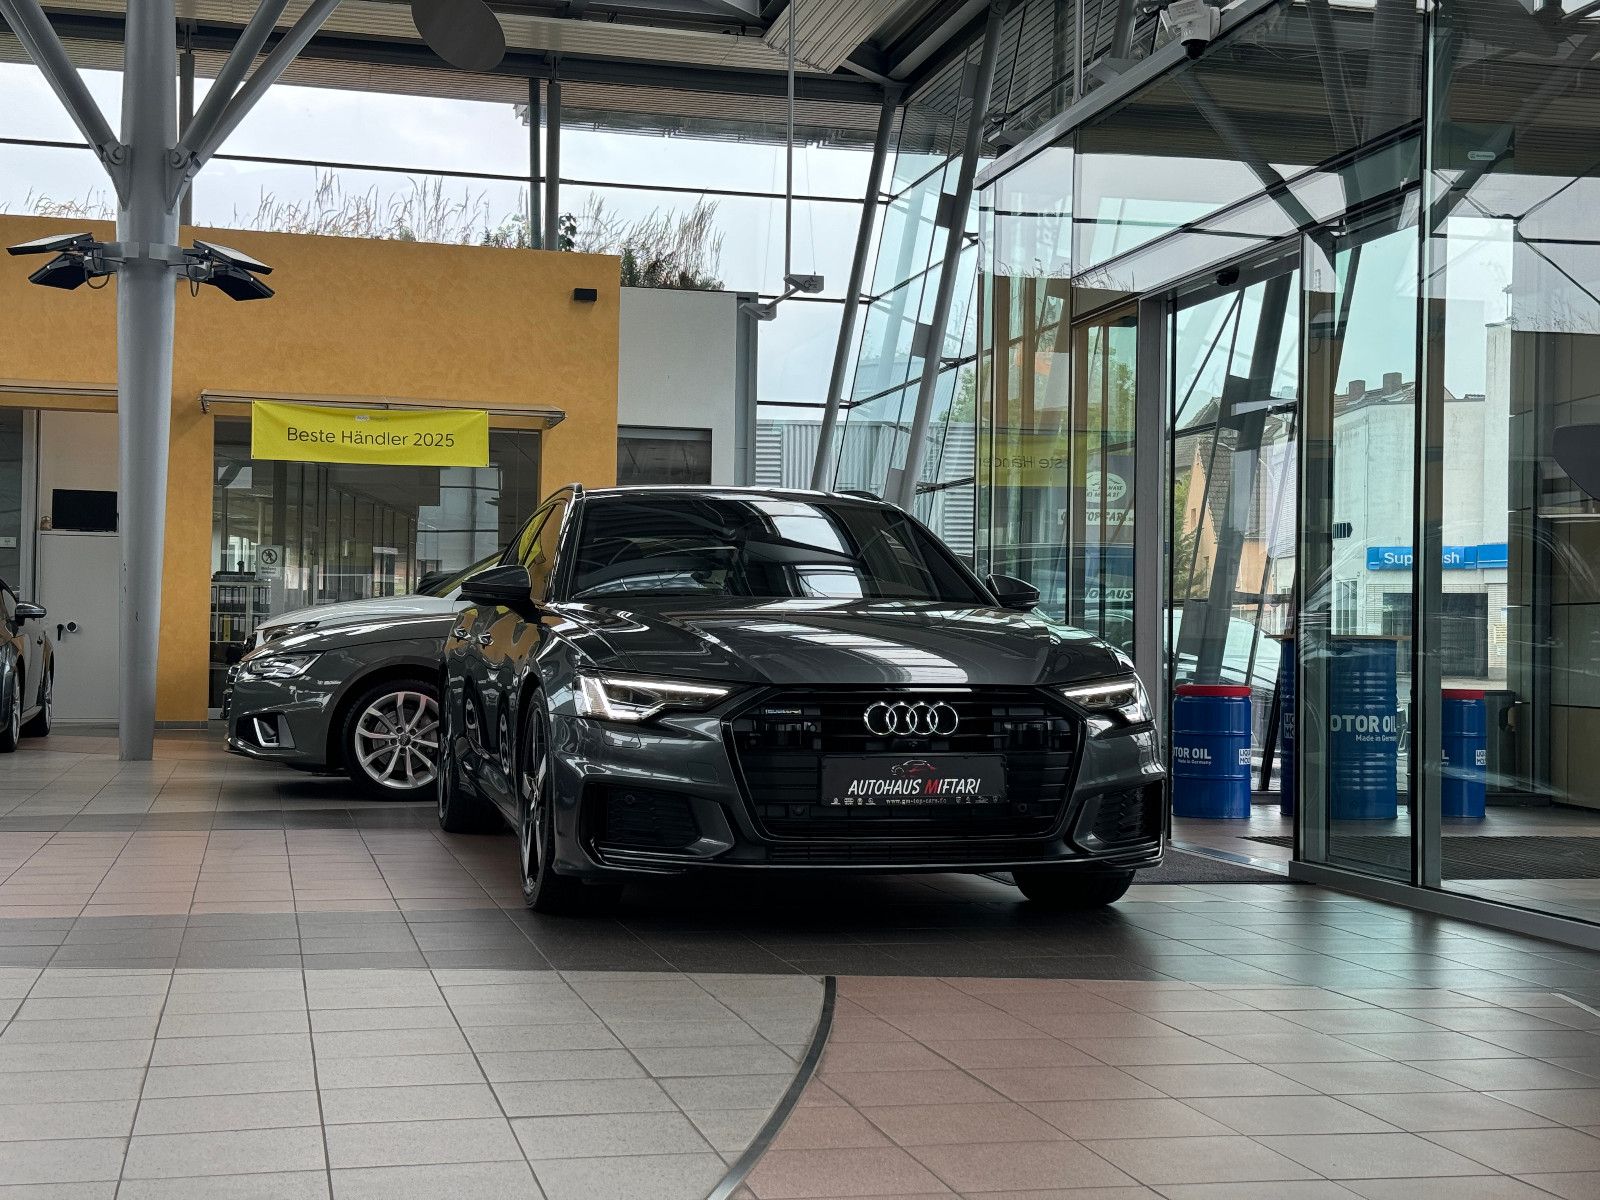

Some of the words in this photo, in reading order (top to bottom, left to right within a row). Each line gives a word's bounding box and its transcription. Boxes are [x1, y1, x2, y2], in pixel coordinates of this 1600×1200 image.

[287, 427, 336, 443] Beste
[341, 429, 409, 446] Händler
[413, 432, 455, 447] 2025
[1330, 714, 1380, 733] OTOR
[1382, 715, 1397, 733] OIL
[1355, 734, 1374, 742] Made
[1375, 734, 1381, 742] in
[1192, 747, 1212, 760] OIL
[848, 779, 922, 796] AUTOHAUS
[924, 778, 981, 795] MIFTARI
